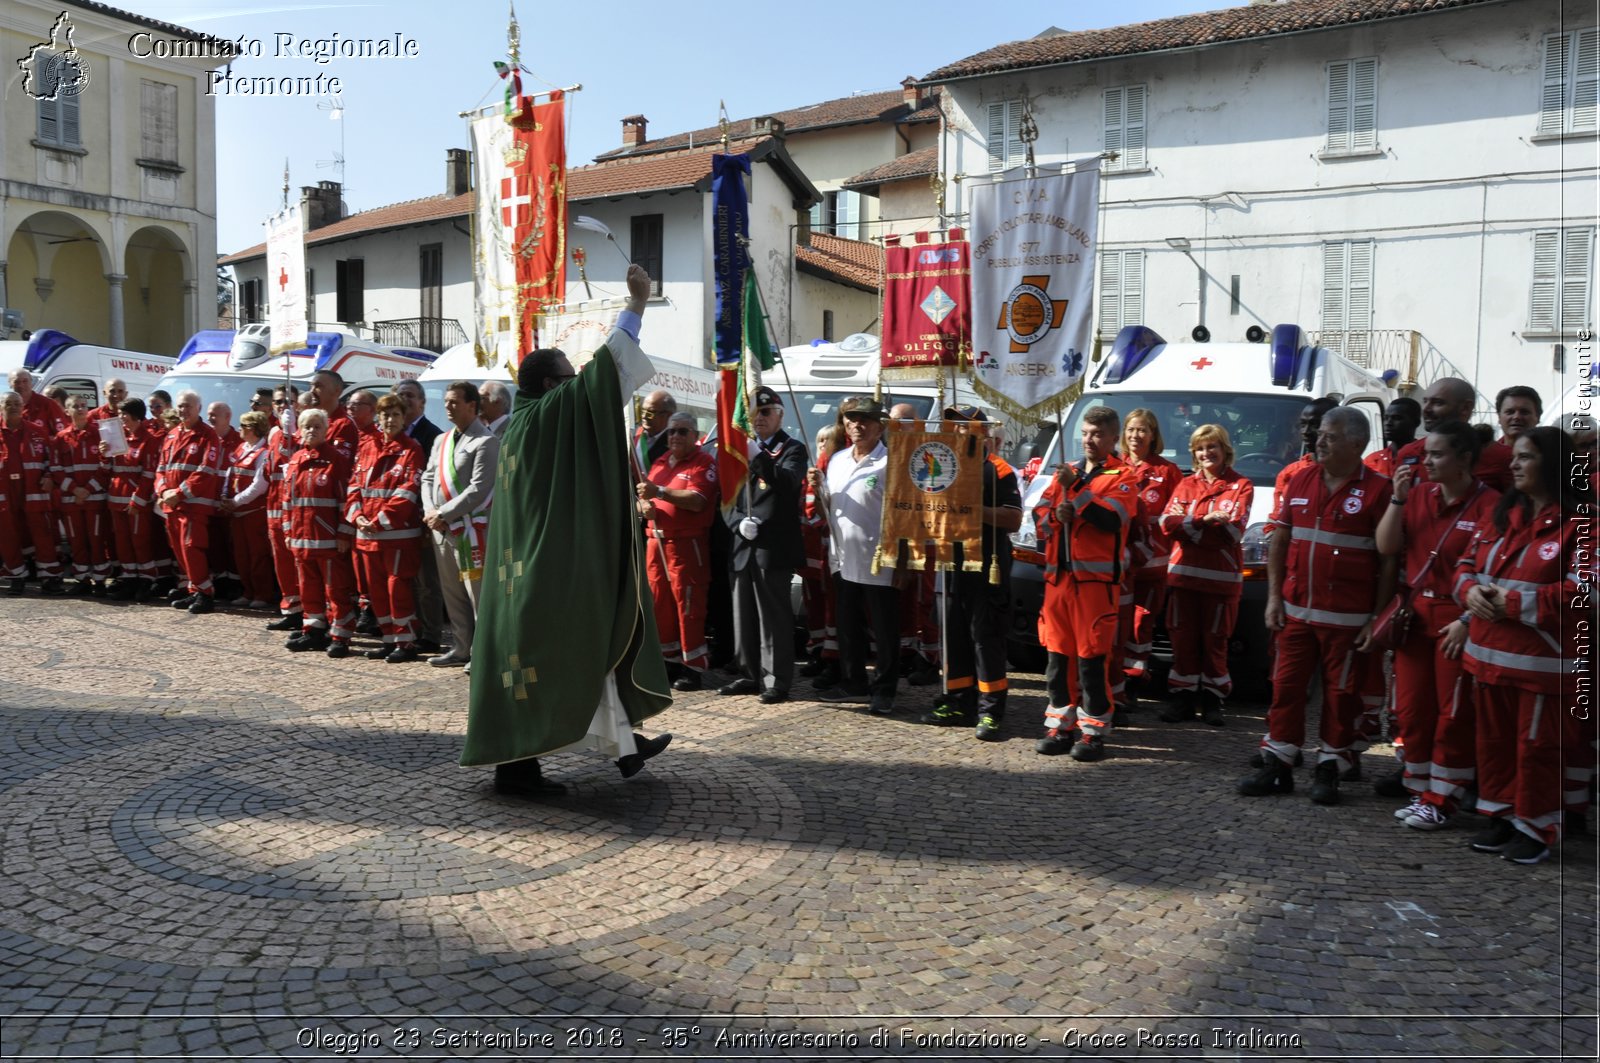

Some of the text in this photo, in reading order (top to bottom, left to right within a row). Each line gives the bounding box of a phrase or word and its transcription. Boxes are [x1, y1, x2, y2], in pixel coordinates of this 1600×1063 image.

[718, 204, 730, 275] CARABINIERI
[973, 229, 1000, 260] CORPO
[1019, 241, 1041, 253] 1977
[919, 248, 960, 264] AVIS
[1023, 253, 1081, 266] ASSISTENZA
[111, 359, 143, 371] UNITA'
[1004, 363, 1057, 376] ANGERA
[671, 375, 700, 394] ROSSA
[894, 502, 913, 511] AREA
[926, 504, 946, 513] BASE
